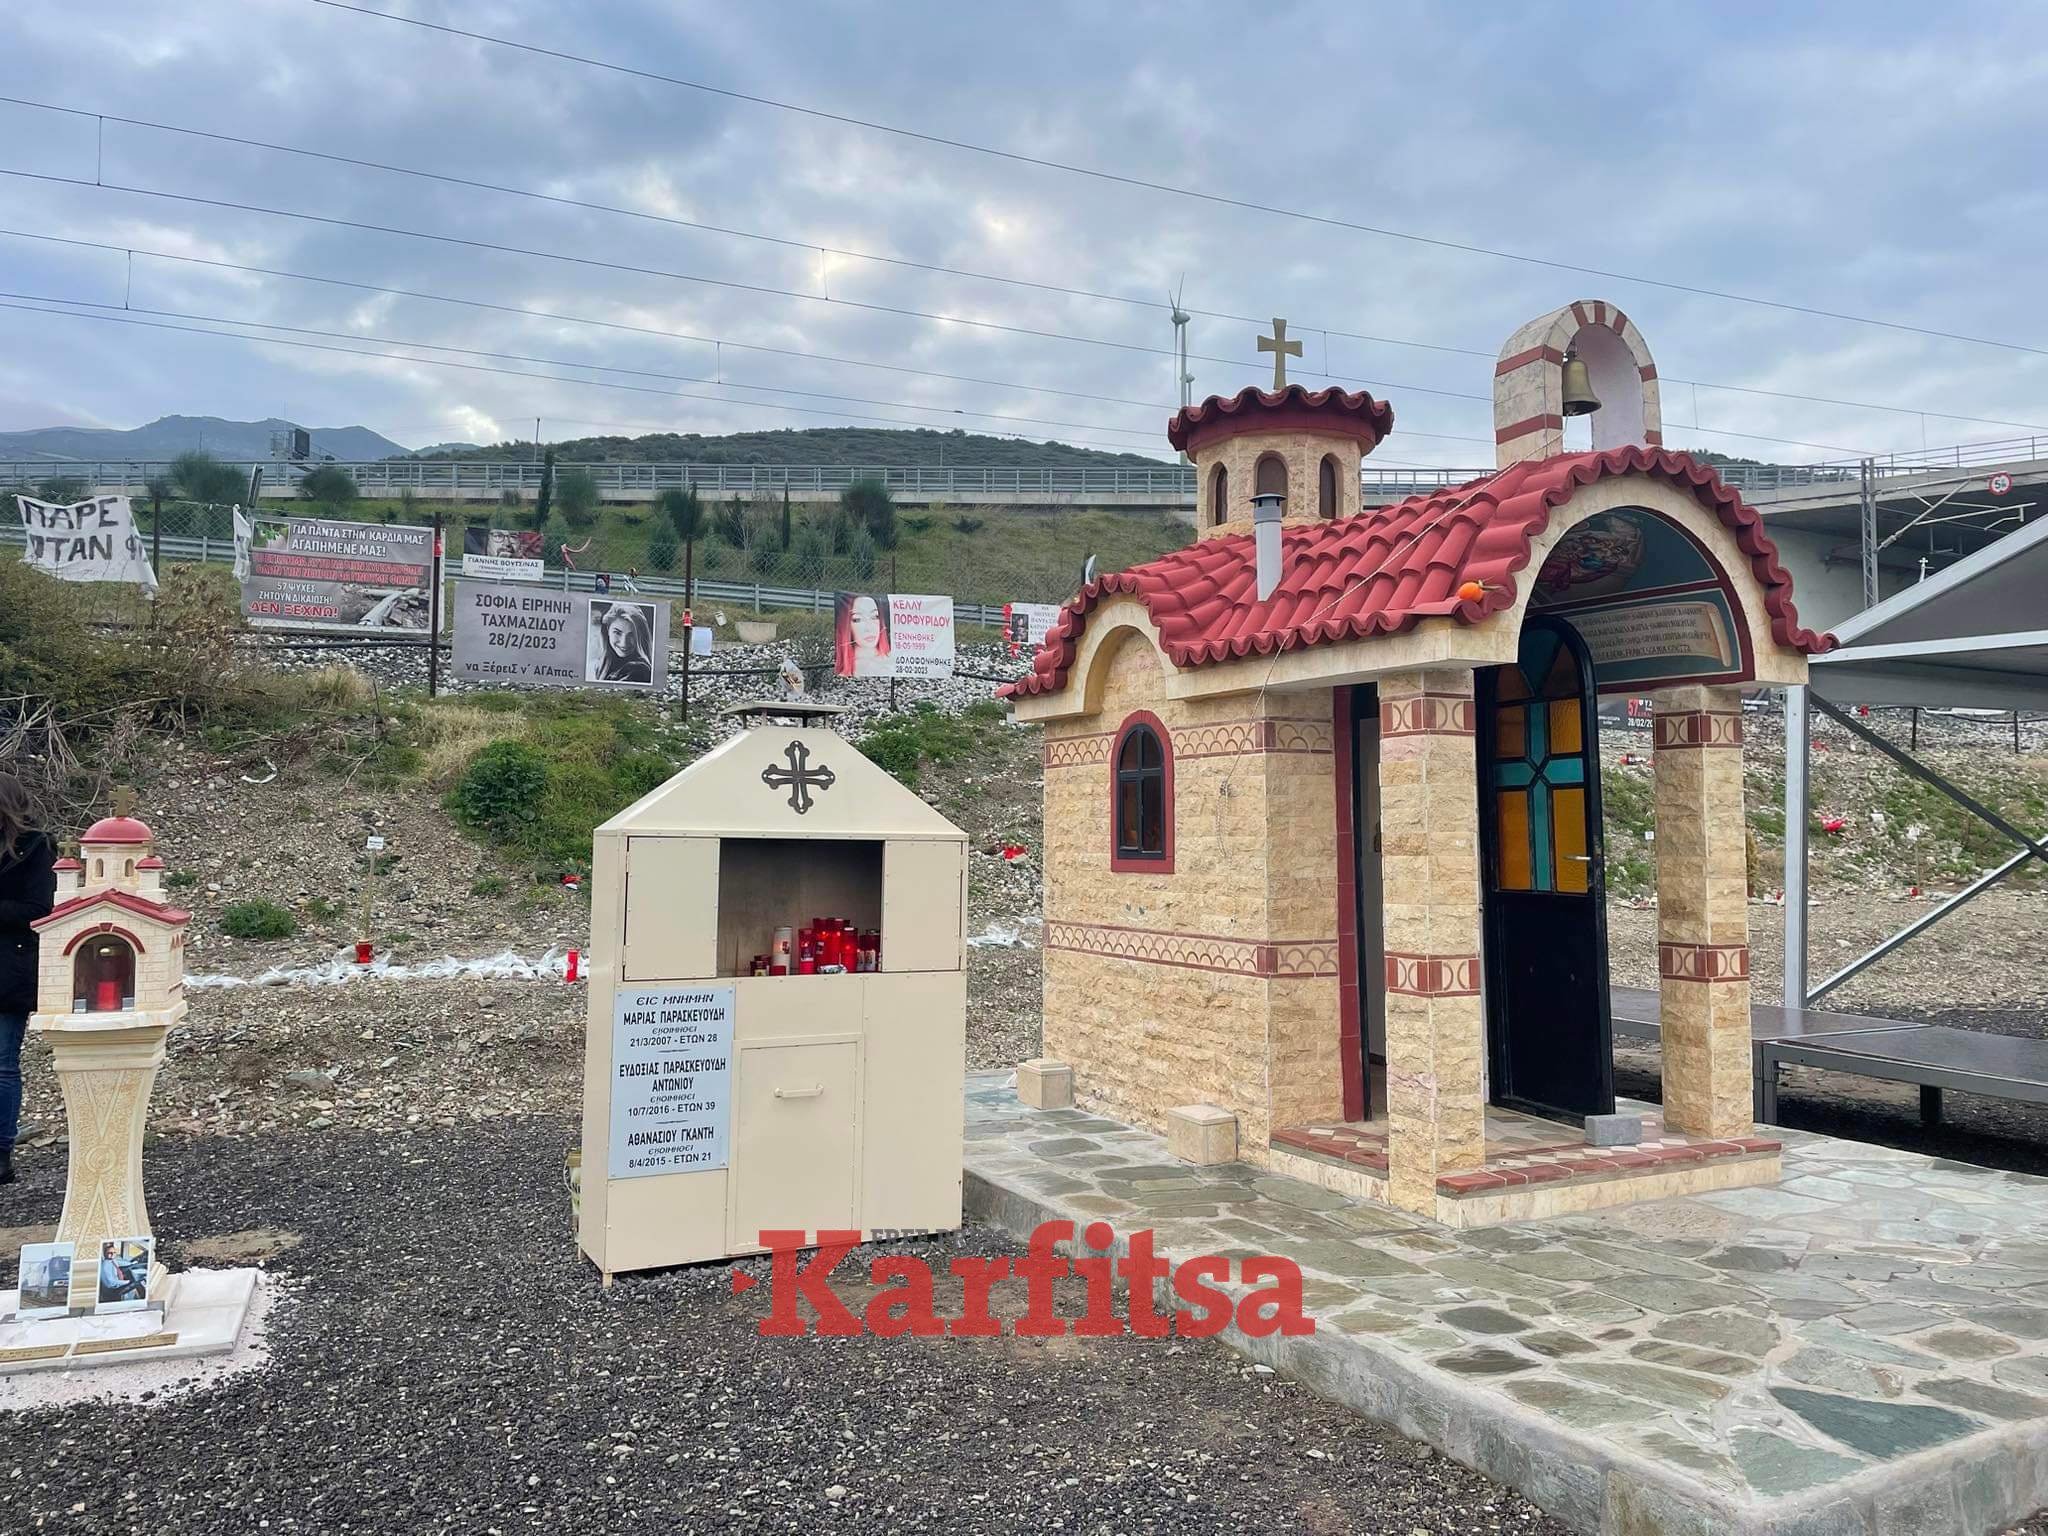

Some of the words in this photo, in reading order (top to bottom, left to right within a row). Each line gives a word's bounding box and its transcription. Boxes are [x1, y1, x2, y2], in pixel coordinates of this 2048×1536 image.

[23, 497, 119, 530] ΠΑΡΕ
[293, 524, 306, 534] ΓΙΑ
[308, 526, 340, 538] ΠΑΝΤΑ
[342, 529, 366, 540] ΣΤΗΝ
[369, 531, 402, 543] ΚΑΡΔΙΑ
[404, 535, 424, 545] ΜΑΣ
[292, 539, 357, 554] ΑΓΑΠΗΜΕΝΕ
[360, 545, 386, 557] ΜΑΣ!
[277, 582, 287, 590] 57
[289, 583, 316, 593] ΨΥΧΕΣ
[259, 591, 291, 601] ΖΗΤΟΥΝ
[475, 593, 517, 610] ΣΟΦΙΑ
[522, 598, 572, 614] ΕΙΡΗΝΗ
[251, 601, 280, 614] ΔΕΝ
[284, 603, 338, 618] ΞΕΧΝΩ!
[893, 600, 922, 610] ΚΕΛΛΥ
[481, 613, 566, 632] ΤΑΧΜΑΖΙΔΟΥ
[894, 614, 951, 627] ΠΟΡΦΥΡΙΔΟΥ
[489, 632, 556, 650] 28/2/2023
[465, 662, 479, 672] να
[663, 994, 714, 1005] ΜΝΗΜΗΝ
[624, 1011, 656, 1025] ΜΑΡΙΑΣ
[660, 1008, 725, 1023] ΠΑΡΑΣΚΕΥΟΥΔΗ
[630, 1036, 672, 1047] 21/3/2007
[679, 1034, 705, 1044] ΕΤΩΝ
[707, 1034, 718, 1042] 28
[619, 1062, 659, 1077] ΕΥΔΟΞΙΑΣ
[663, 1058, 726, 1075] ΠΑΡΑΣΚΕΥΟΥΔΗ
[652, 1077, 694, 1092] ΑΝΤΩΝΙΟΥ
[628, 1105, 670, 1117] 10/7/2016
[677, 1103, 703, 1112] ΕΤΩΝ
[705, 1101, 716, 1110] 39
[628, 1129, 677, 1146] ΑΘΑΝΑΣΙΟΥ
[681, 1126, 714, 1142] ΓΚΑΝΤΗ
[629, 1157, 666, 1168] 8/4/2015
[674, 1154, 699, 1164] ΕΤΩΝ
[702, 1152, 711, 1161] 21
